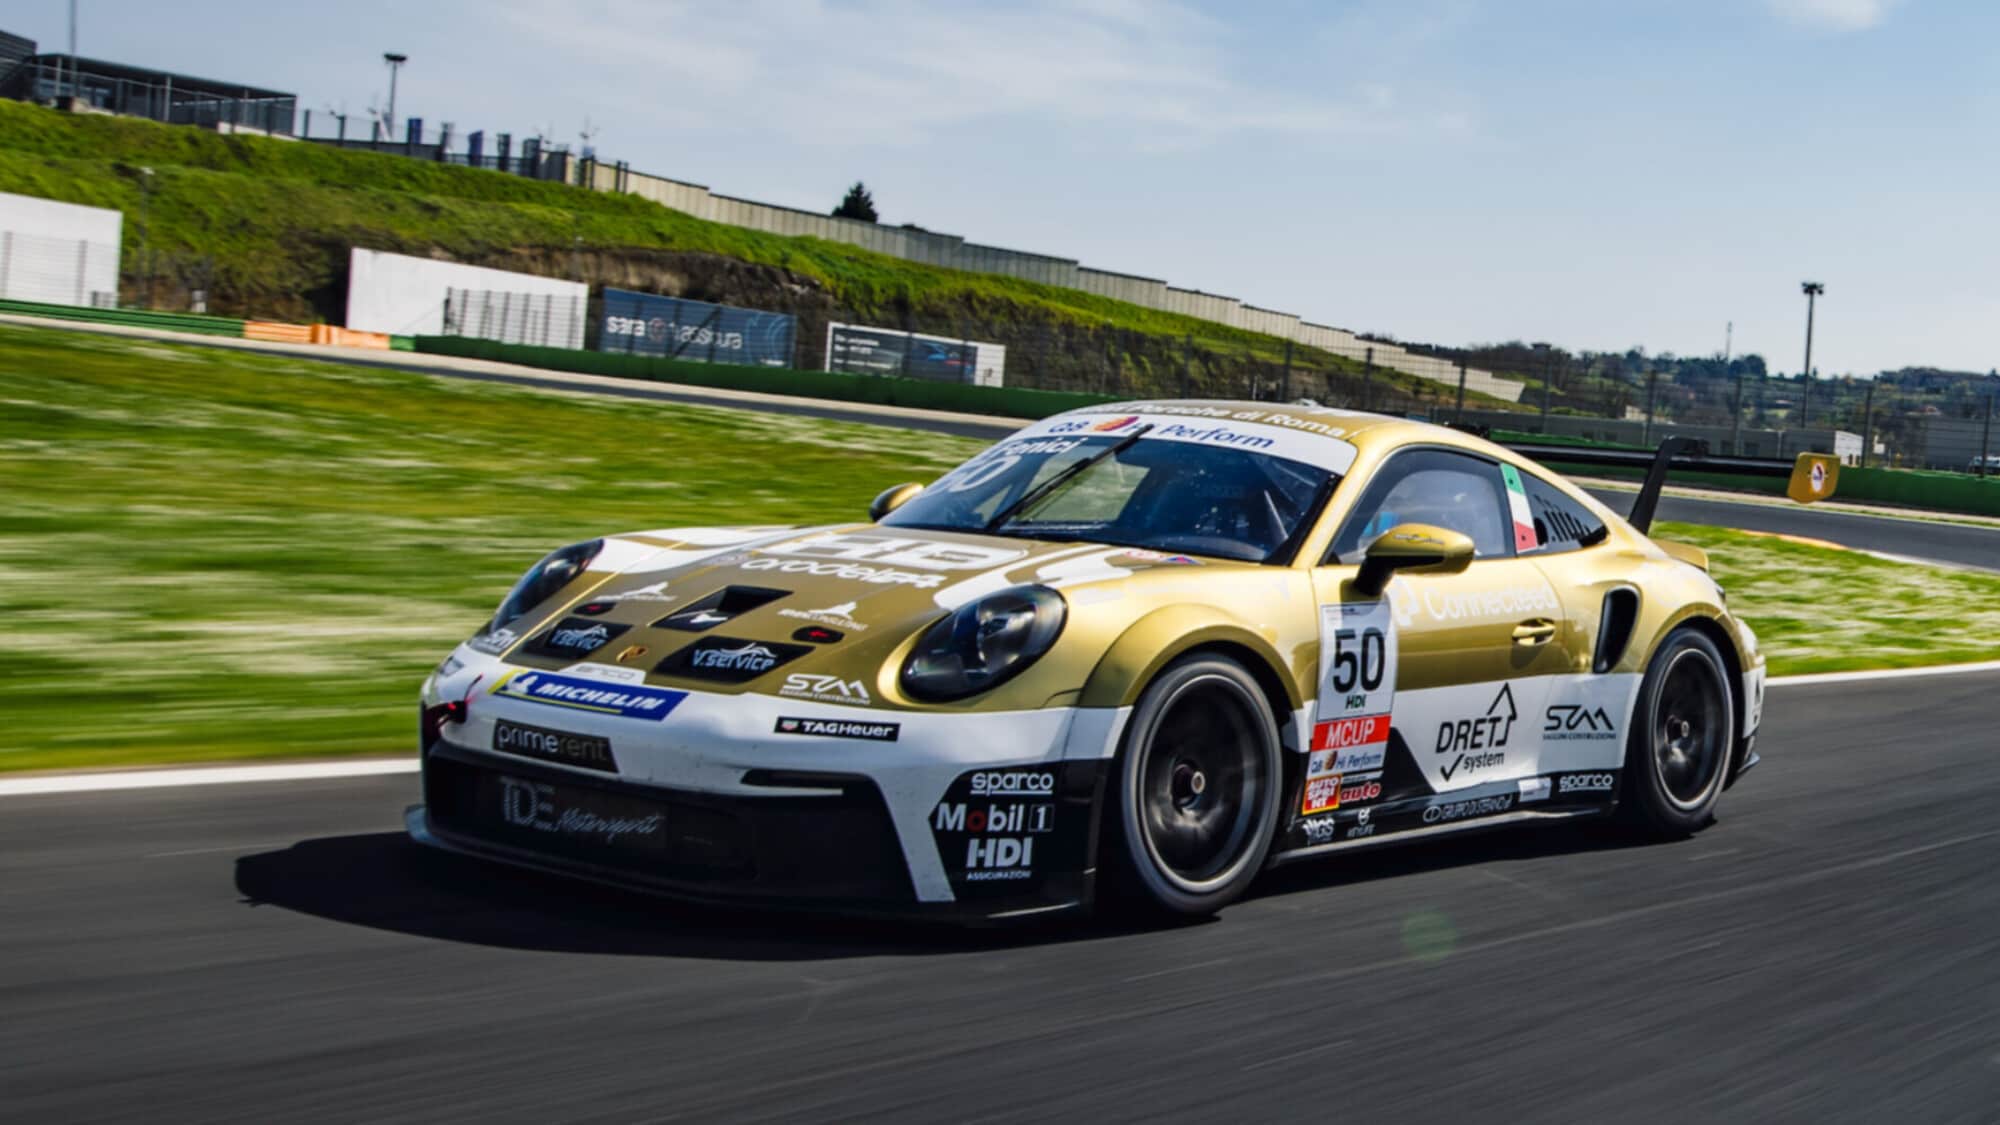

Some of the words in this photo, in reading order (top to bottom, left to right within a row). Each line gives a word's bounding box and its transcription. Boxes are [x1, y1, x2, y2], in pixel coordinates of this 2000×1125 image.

[1158, 424, 1276, 450] Perform
[1332, 626, 1386, 694] 50
[536, 683, 666, 710] MICHELIN
[498, 726, 608, 762] primerent
[1326, 718, 1376, 748] MCUP
[1463, 751, 1505, 773] system
[970, 772, 1054, 797] sparco
[1559, 773, 1614, 793] sparco
[936, 802, 1025, 832] Mobil
[1036, 806, 1047, 831] 1
[966, 836, 1034, 868] HDI
